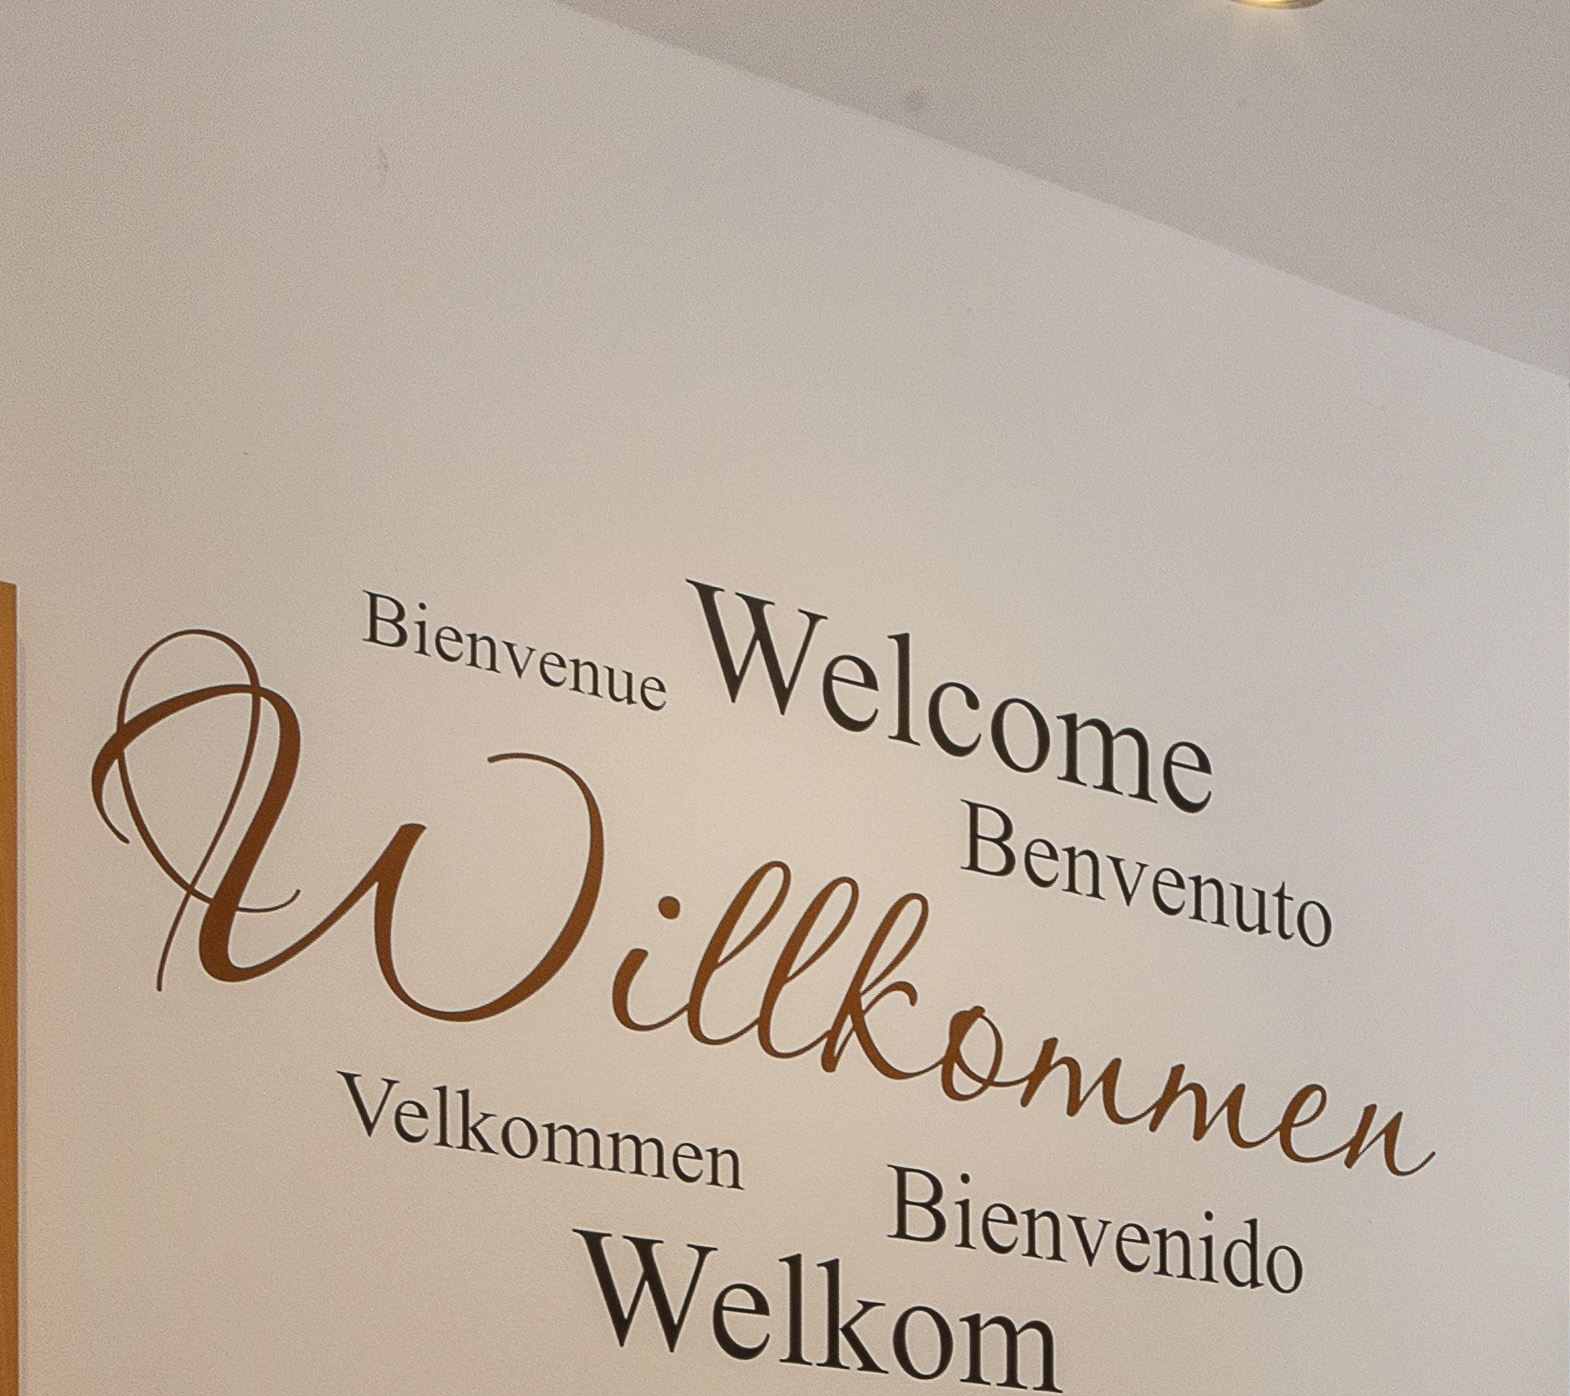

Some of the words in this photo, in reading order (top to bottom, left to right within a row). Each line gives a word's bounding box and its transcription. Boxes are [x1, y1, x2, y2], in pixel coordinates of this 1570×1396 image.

[361, 589, 669, 712] Bienvenue
[685, 579, 1215, 815] Welcome
[91, 628, 1436, 1179] Willkommen
[959, 799, 1335, 948] Benvenuto
[335, 1070, 745, 1191] Velkommen
[886, 1164, 1305, 1296] Bienvenido
[572, 1229, 1064, 1395] Welkom
